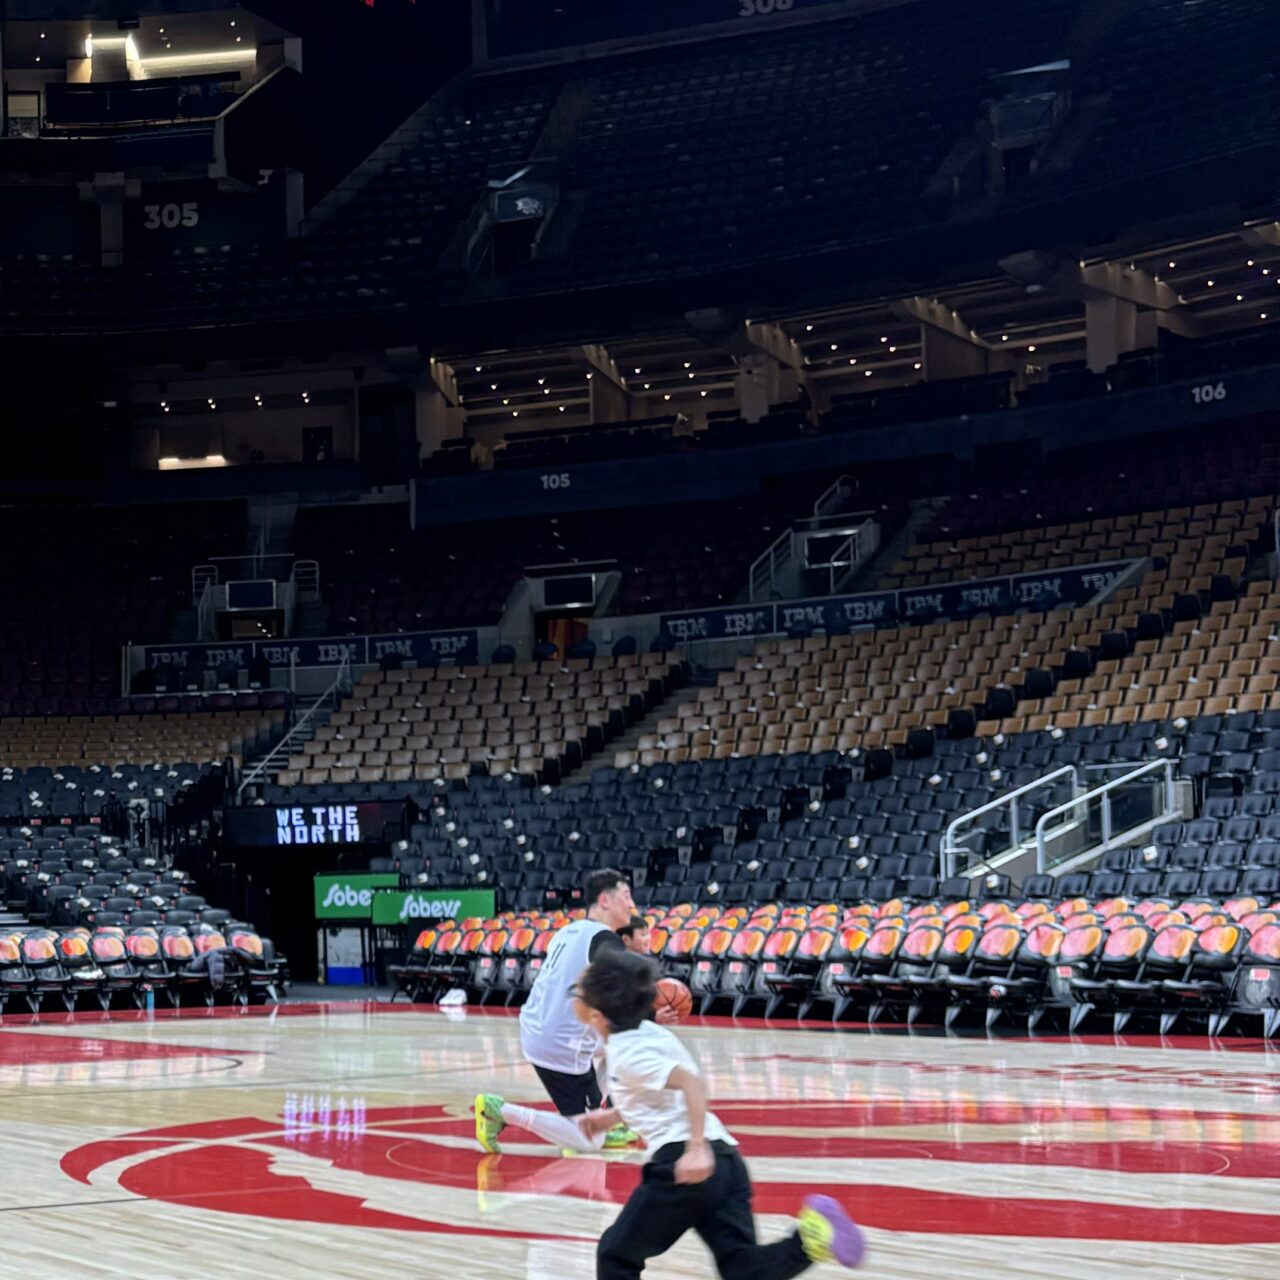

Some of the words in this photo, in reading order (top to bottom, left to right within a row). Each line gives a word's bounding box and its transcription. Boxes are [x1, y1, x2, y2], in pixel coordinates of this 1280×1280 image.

[144, 202, 199, 229] 305
[1191, 382, 1226, 403] 106
[540, 473, 571, 489] 105
[843, 600, 885, 621] IBM
[666, 617, 708, 637] IBM
[724, 611, 768, 633] IBM
[262, 646, 301, 664] IBM
[317, 643, 357, 662] IBM
[276, 808, 304, 826] WE
[312, 806, 358, 825] THE
[277, 825, 360, 845] NORTH
[322, 883, 370, 908] Sobe
